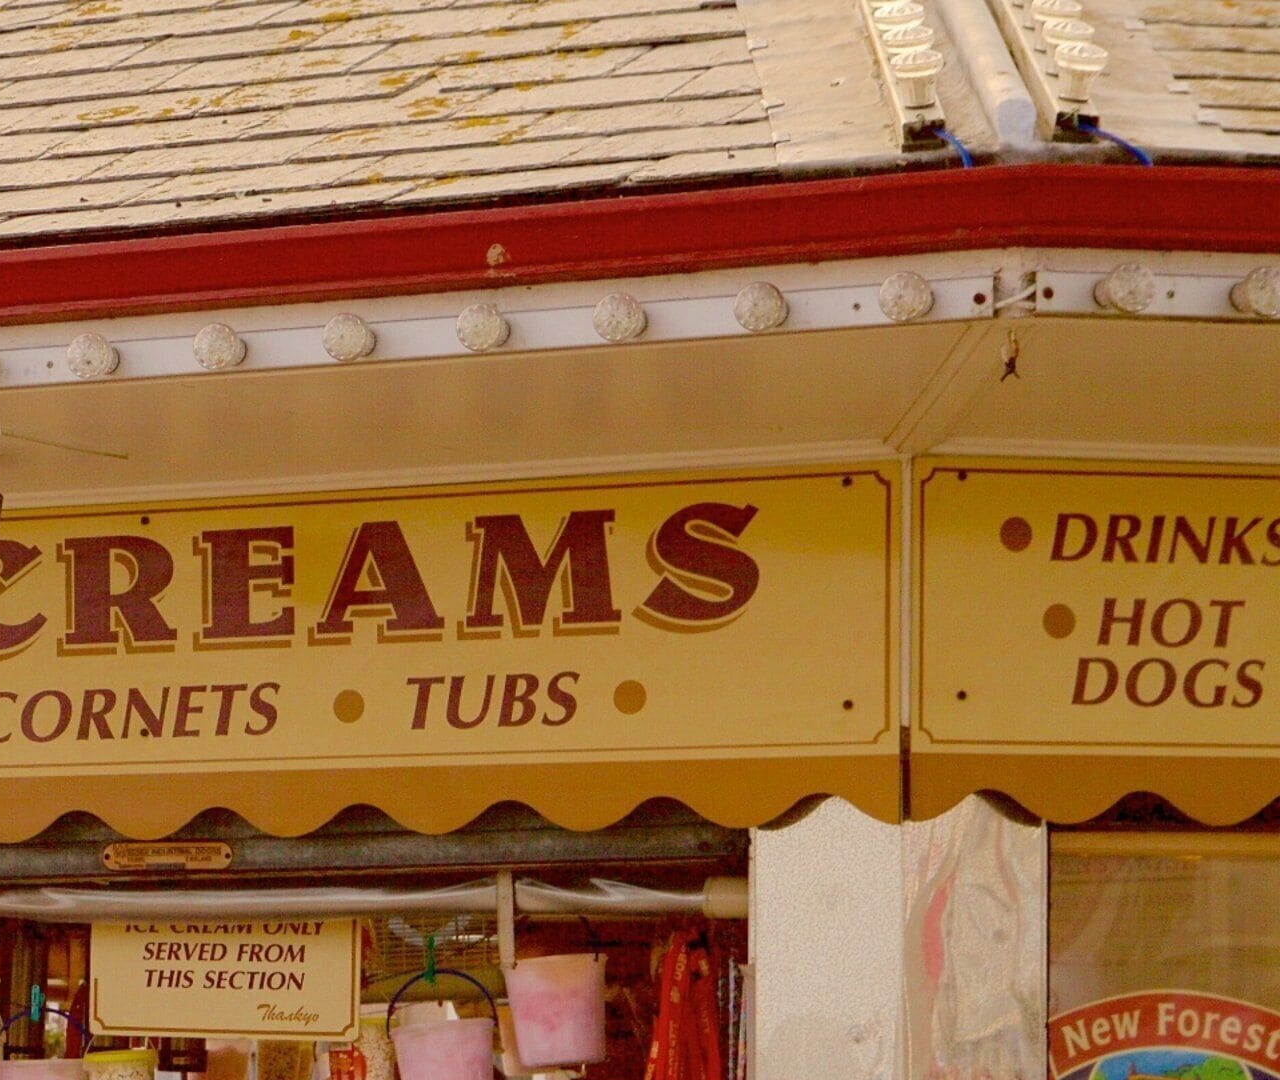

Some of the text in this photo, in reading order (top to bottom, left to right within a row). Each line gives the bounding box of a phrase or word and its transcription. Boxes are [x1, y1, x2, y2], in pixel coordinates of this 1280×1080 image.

[1097, 598, 1246, 648] HOT
[406, 671, 580, 730] TUBS
[1071, 657, 1266, 709] DOGS
[142, 942, 306, 963] SERVED FROM
[144, 969, 306, 991] THIS SECTION
[1061, 1003, 1280, 1060] New Forest
